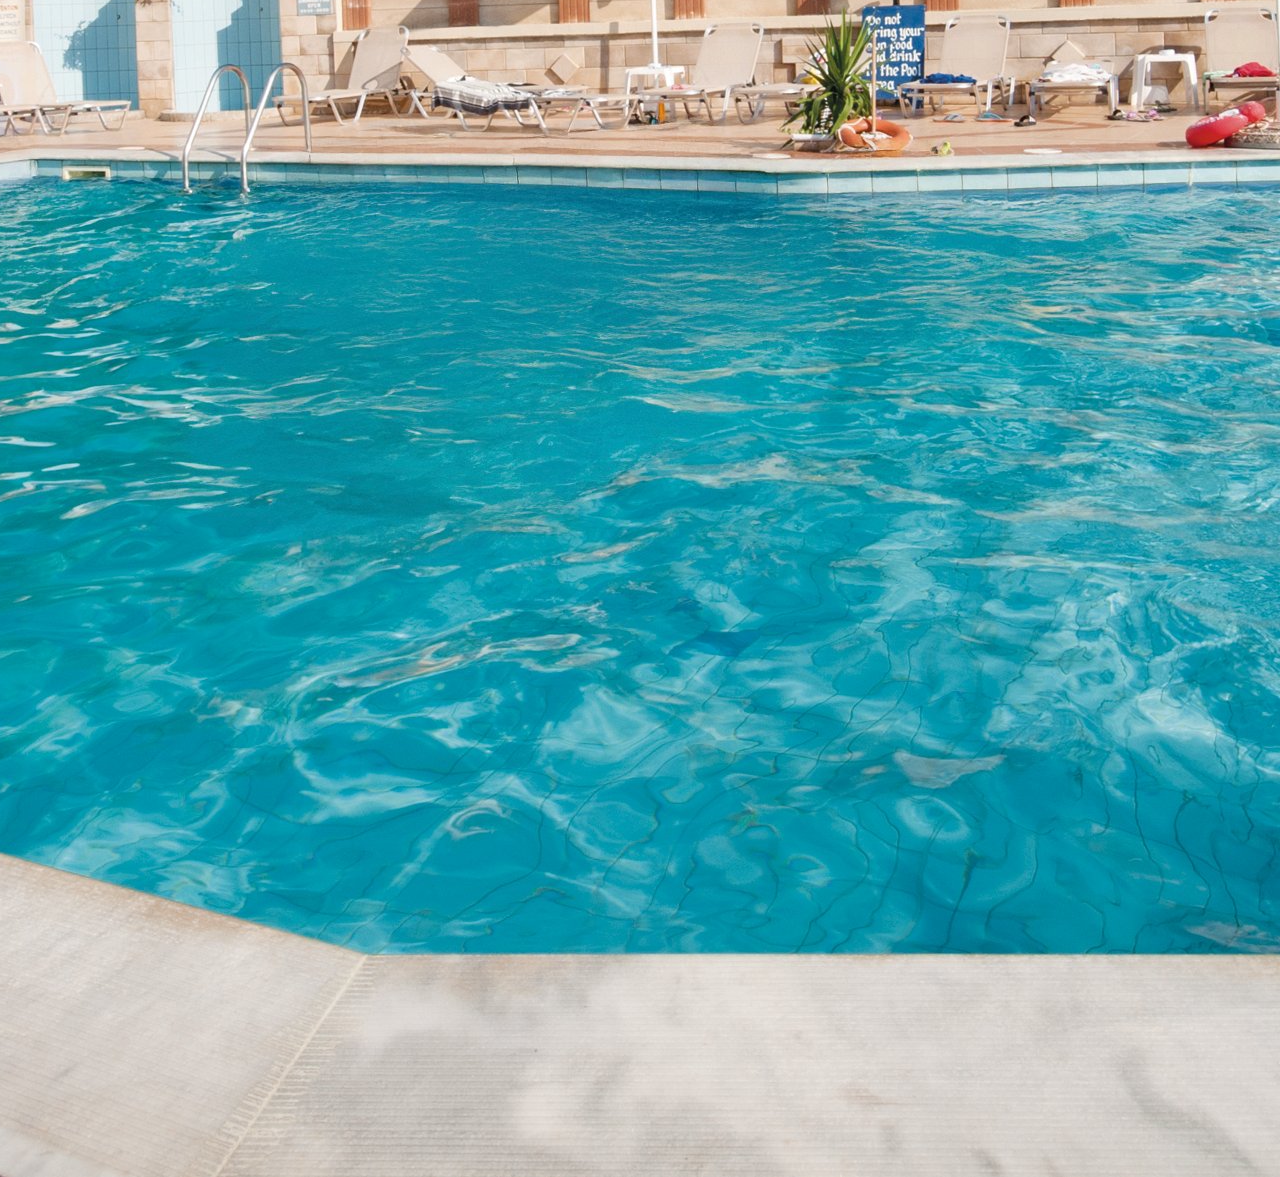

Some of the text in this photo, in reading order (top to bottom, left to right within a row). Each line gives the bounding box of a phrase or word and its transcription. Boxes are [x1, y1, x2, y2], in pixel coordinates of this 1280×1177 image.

[884, 12, 902, 25] not
[898, 27, 925, 41] your
[889, 49, 922, 62] drink
[880, 63, 900, 77] the
[900, 62, 922, 77] Pool
